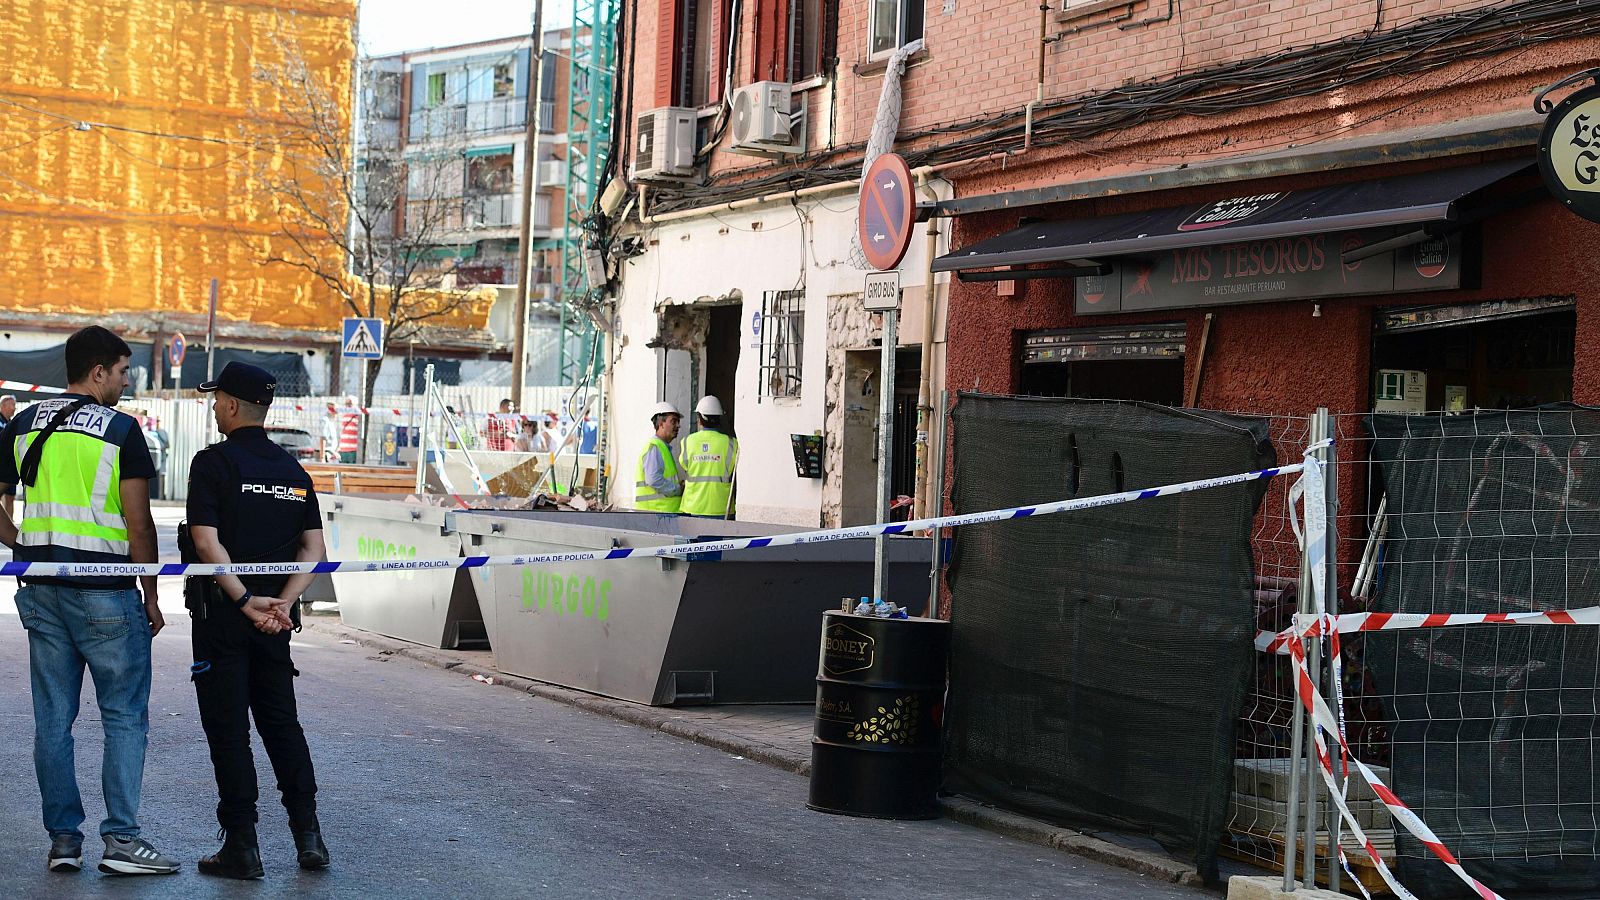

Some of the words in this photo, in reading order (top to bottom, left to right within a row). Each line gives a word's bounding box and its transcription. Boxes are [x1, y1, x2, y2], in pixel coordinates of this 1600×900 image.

[1171, 249, 1213, 284] MIS
[1222, 235, 1326, 279] TESOROS
[868, 282, 882, 298] GIRO
[882, 281, 895, 298] BUS
[1204, 286, 1216, 296] BAR
[1217, 282, 1257, 295] RESTAURANTE
[1257, 280, 1286, 292] PERUANO
[1381, 373, 1403, 400] H
[241, 484, 295, 496] POLICIA
[274, 494, 306, 502] NACIONAL
[841, 531, 870, 539] POLICIA
[670, 546, 692, 554] LINEA
[705, 543, 735, 551] POLICIA
[564, 553, 594, 561] POLICIA
[255, 565, 267, 573] DE
[268, 564, 300, 573] POLICIA
[418, 560, 450, 568] POLICIA
[113, 566, 147, 574] POLICIA
[521, 566, 612, 621] BURGOS
